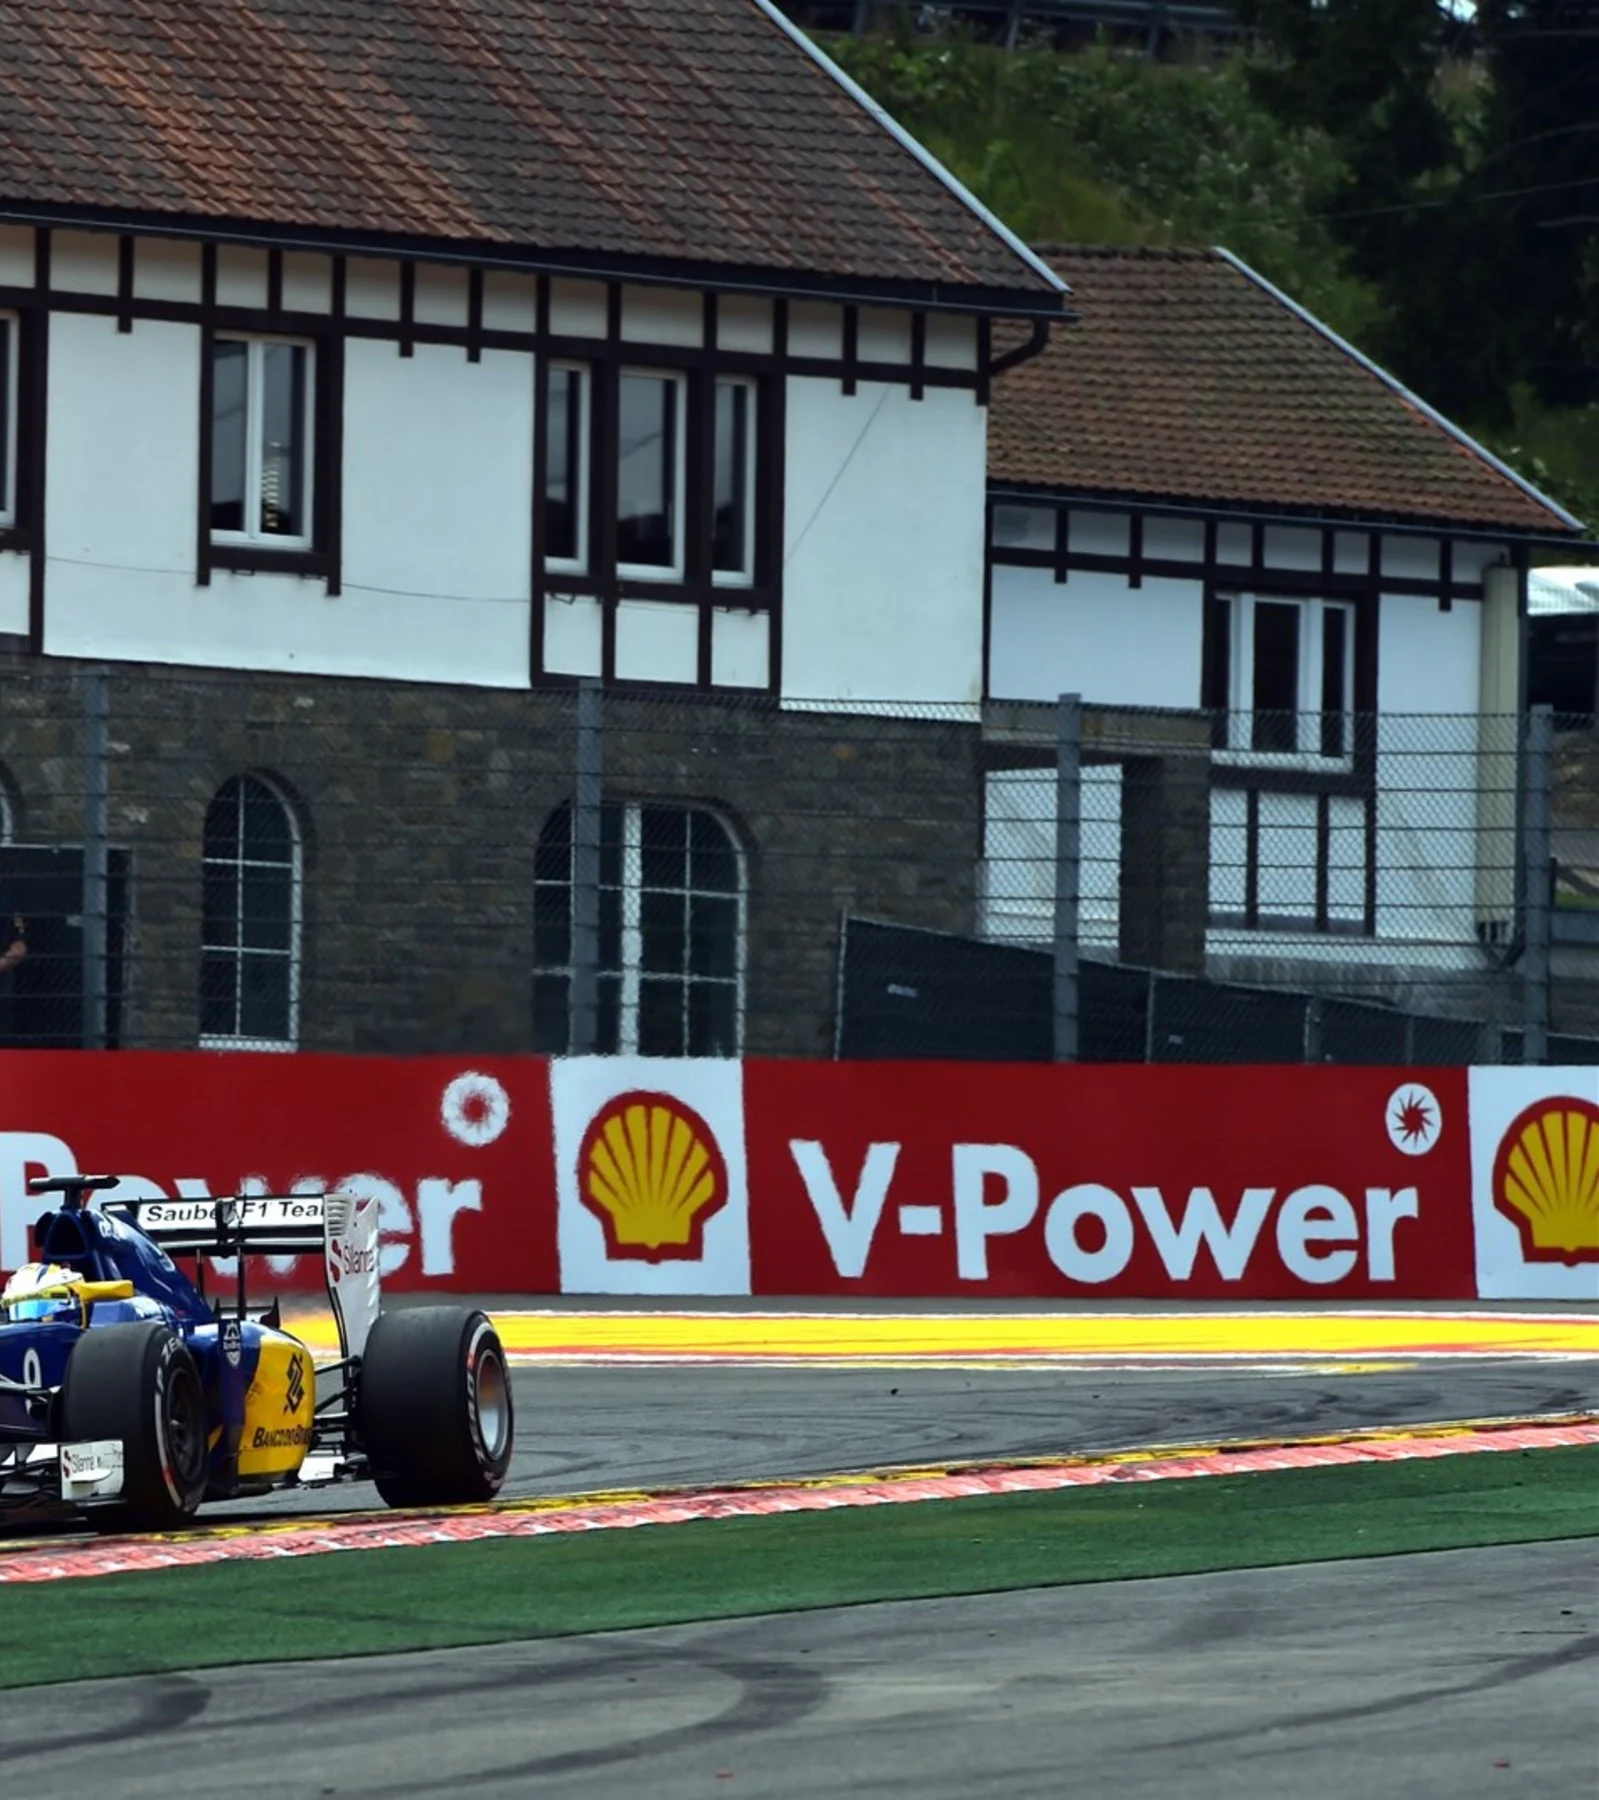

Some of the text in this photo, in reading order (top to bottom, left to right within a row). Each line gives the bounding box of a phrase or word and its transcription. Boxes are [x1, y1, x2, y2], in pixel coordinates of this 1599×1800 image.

[146, 1201, 325, 1222] Saube F1 Tea
[788, 1138, 1418, 1284] V-Power
